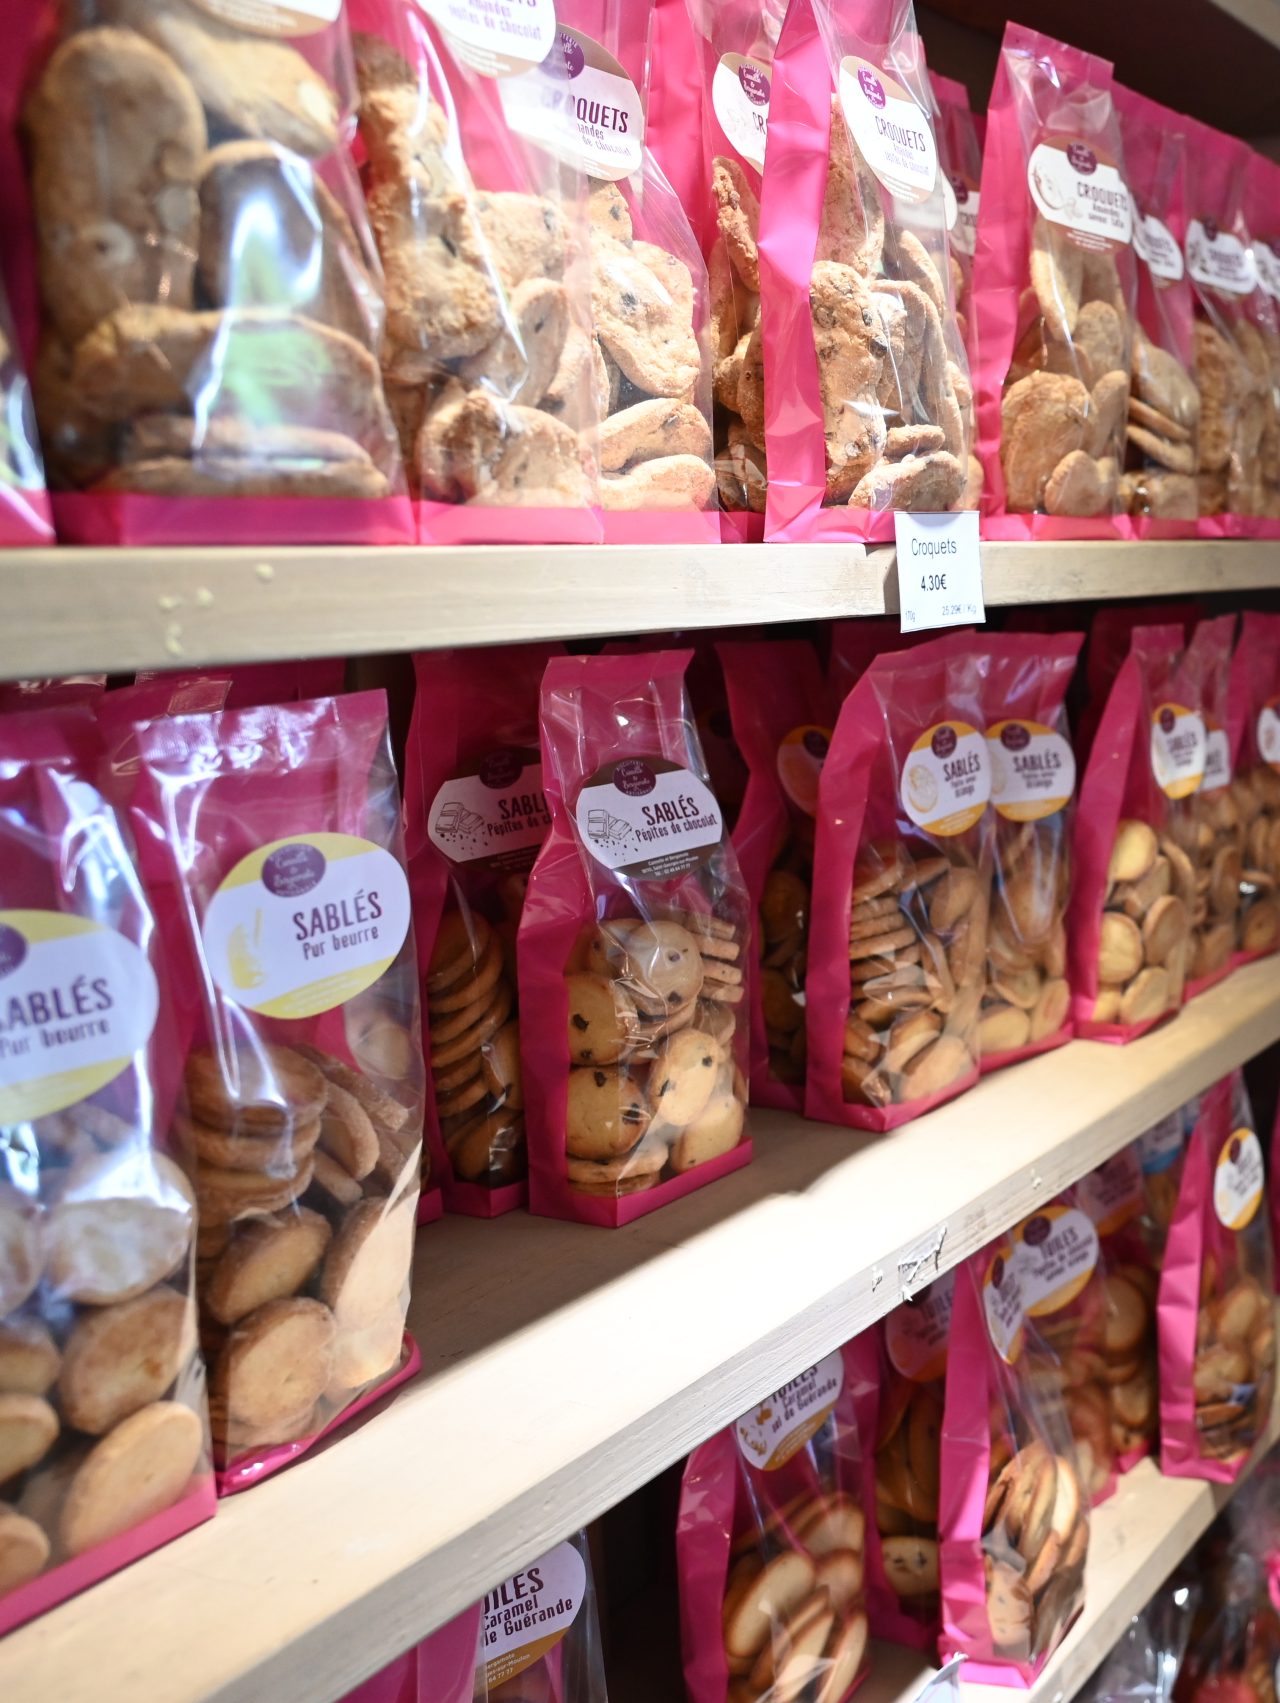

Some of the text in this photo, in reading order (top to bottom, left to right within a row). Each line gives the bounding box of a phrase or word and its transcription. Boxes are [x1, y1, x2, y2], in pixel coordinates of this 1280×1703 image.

[912, 538, 957, 559] Croquets
[921, 574, 947, 591] 4.30€
[943, 751, 980, 781] SABLÉS
[1013, 749, 1061, 773] SABLÉS
[641, 794, 699, 826] SABLÉS
[635, 813, 718, 842] Pépites de chocolat
[292, 888, 382, 941] SABLÉS
[302, 926, 379, 961] Pur beurre
[42, 1019, 109, 1049] beurre
[484, 1567, 544, 1614] ILES
[504, 1598, 573, 1636] Guérande
